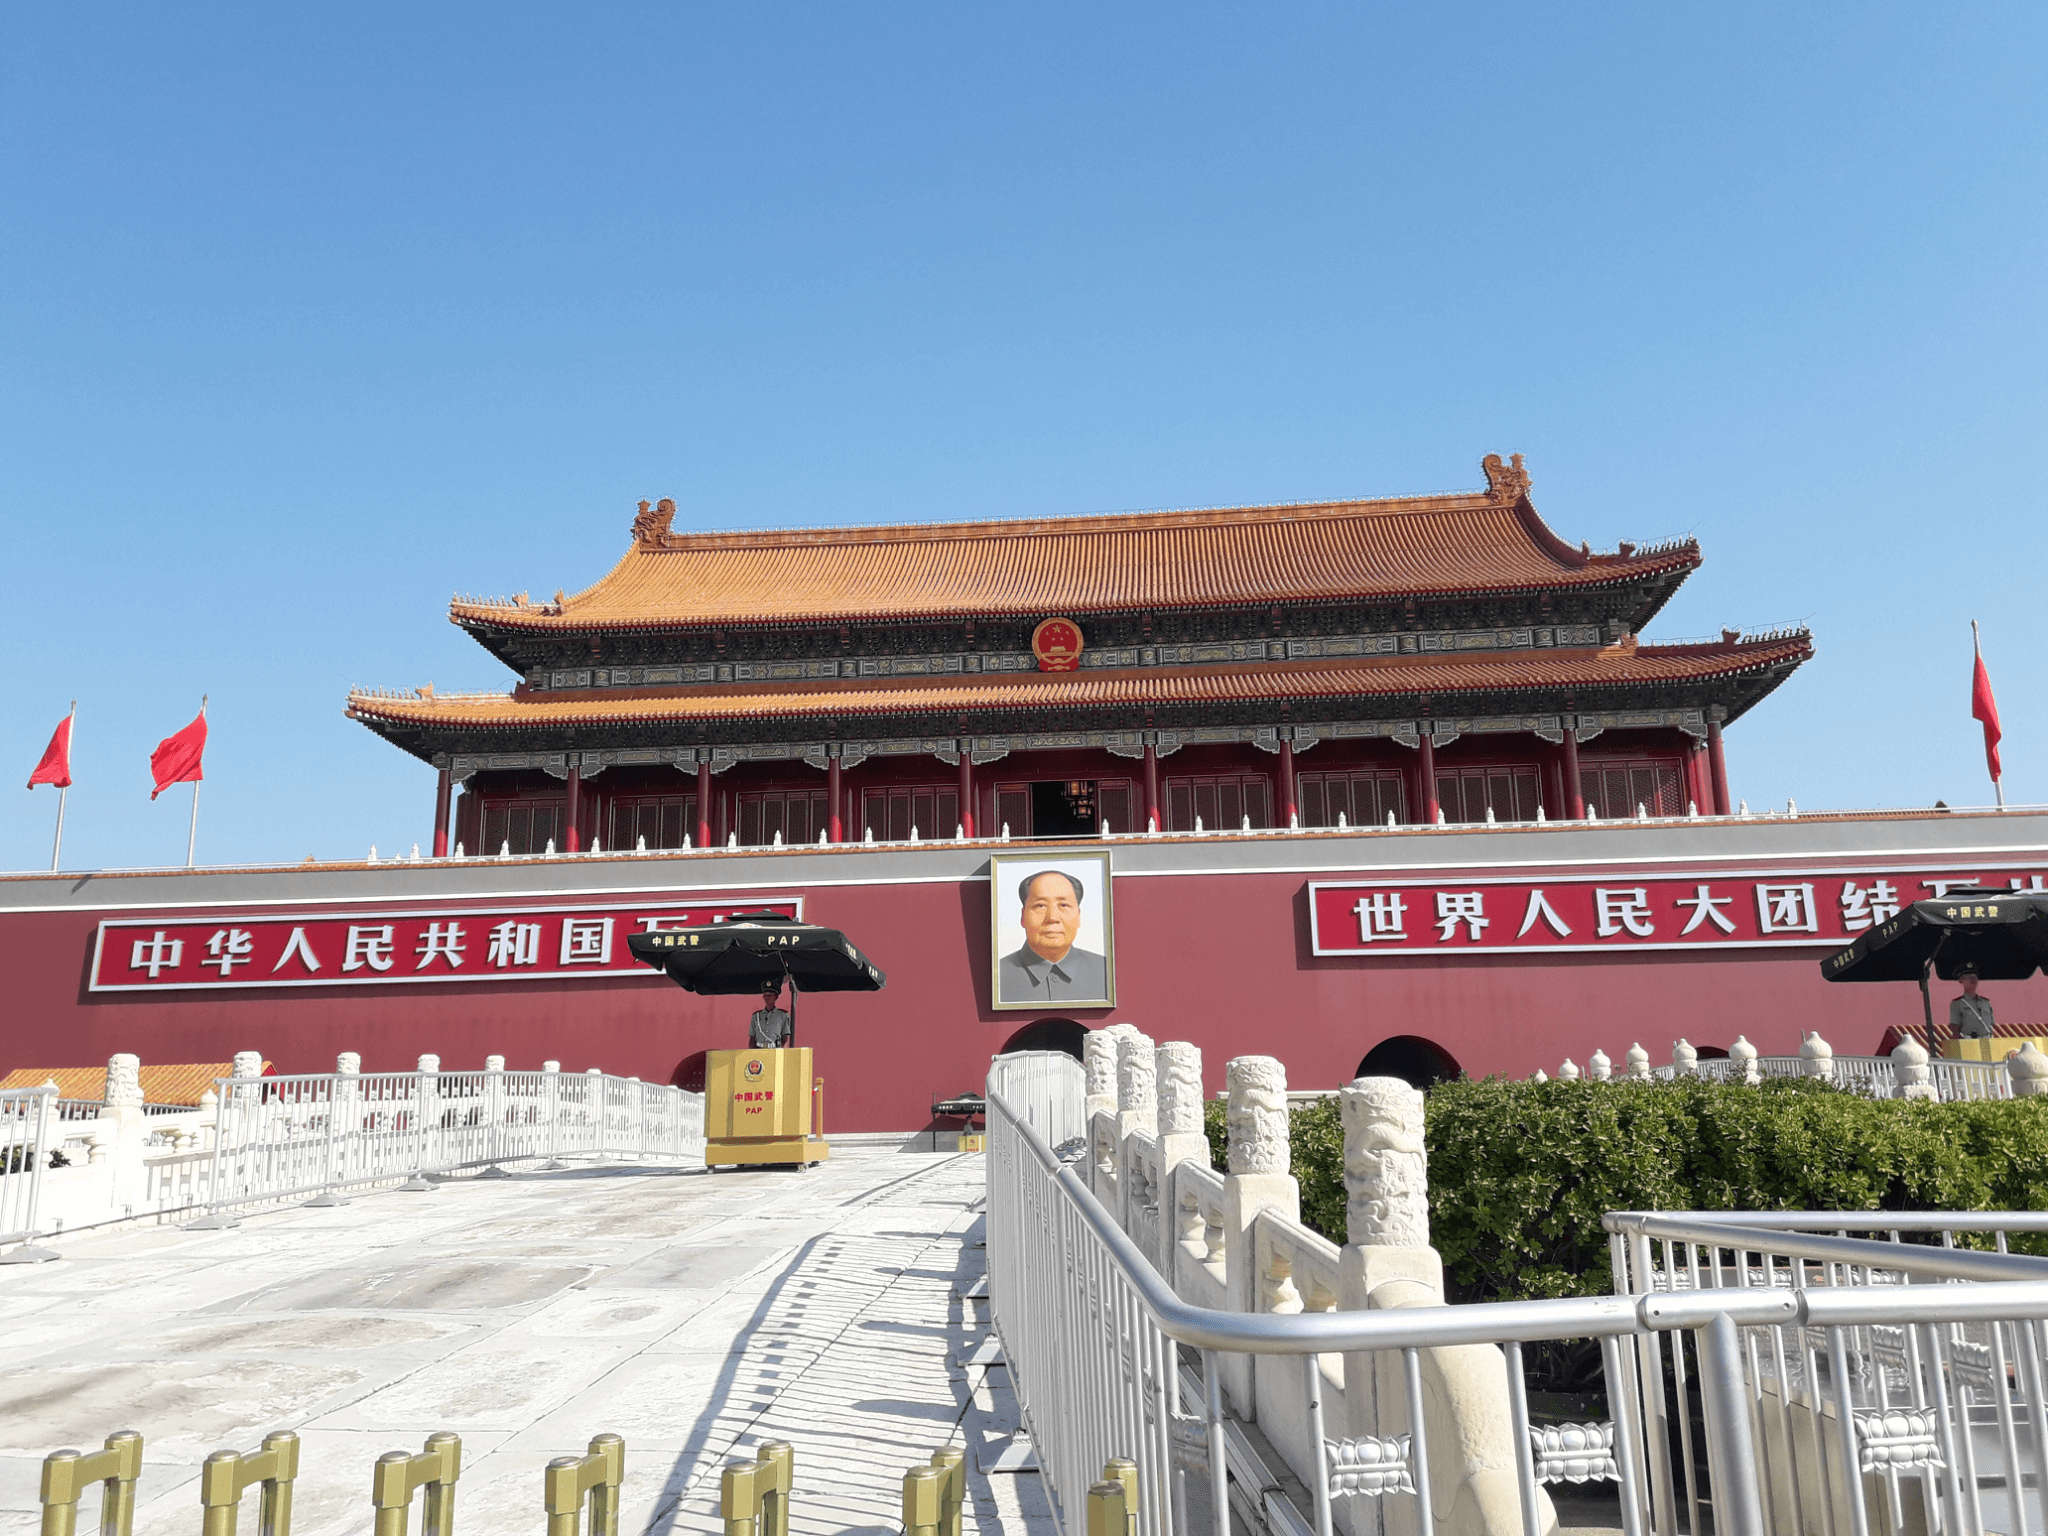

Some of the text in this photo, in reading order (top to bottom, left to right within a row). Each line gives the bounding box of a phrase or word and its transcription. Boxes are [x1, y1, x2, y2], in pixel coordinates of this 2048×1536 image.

[1946, 904, 1999, 919] 中国武警
[1882, 921, 1898, 939] PAP
[131, 912, 744, 978] 中华人民共和国
[652, 934, 800, 947] 中国武警 PAP
[734, 1091, 774, 1102] 中国武警
[745, 1107, 763, 1115] PAP
